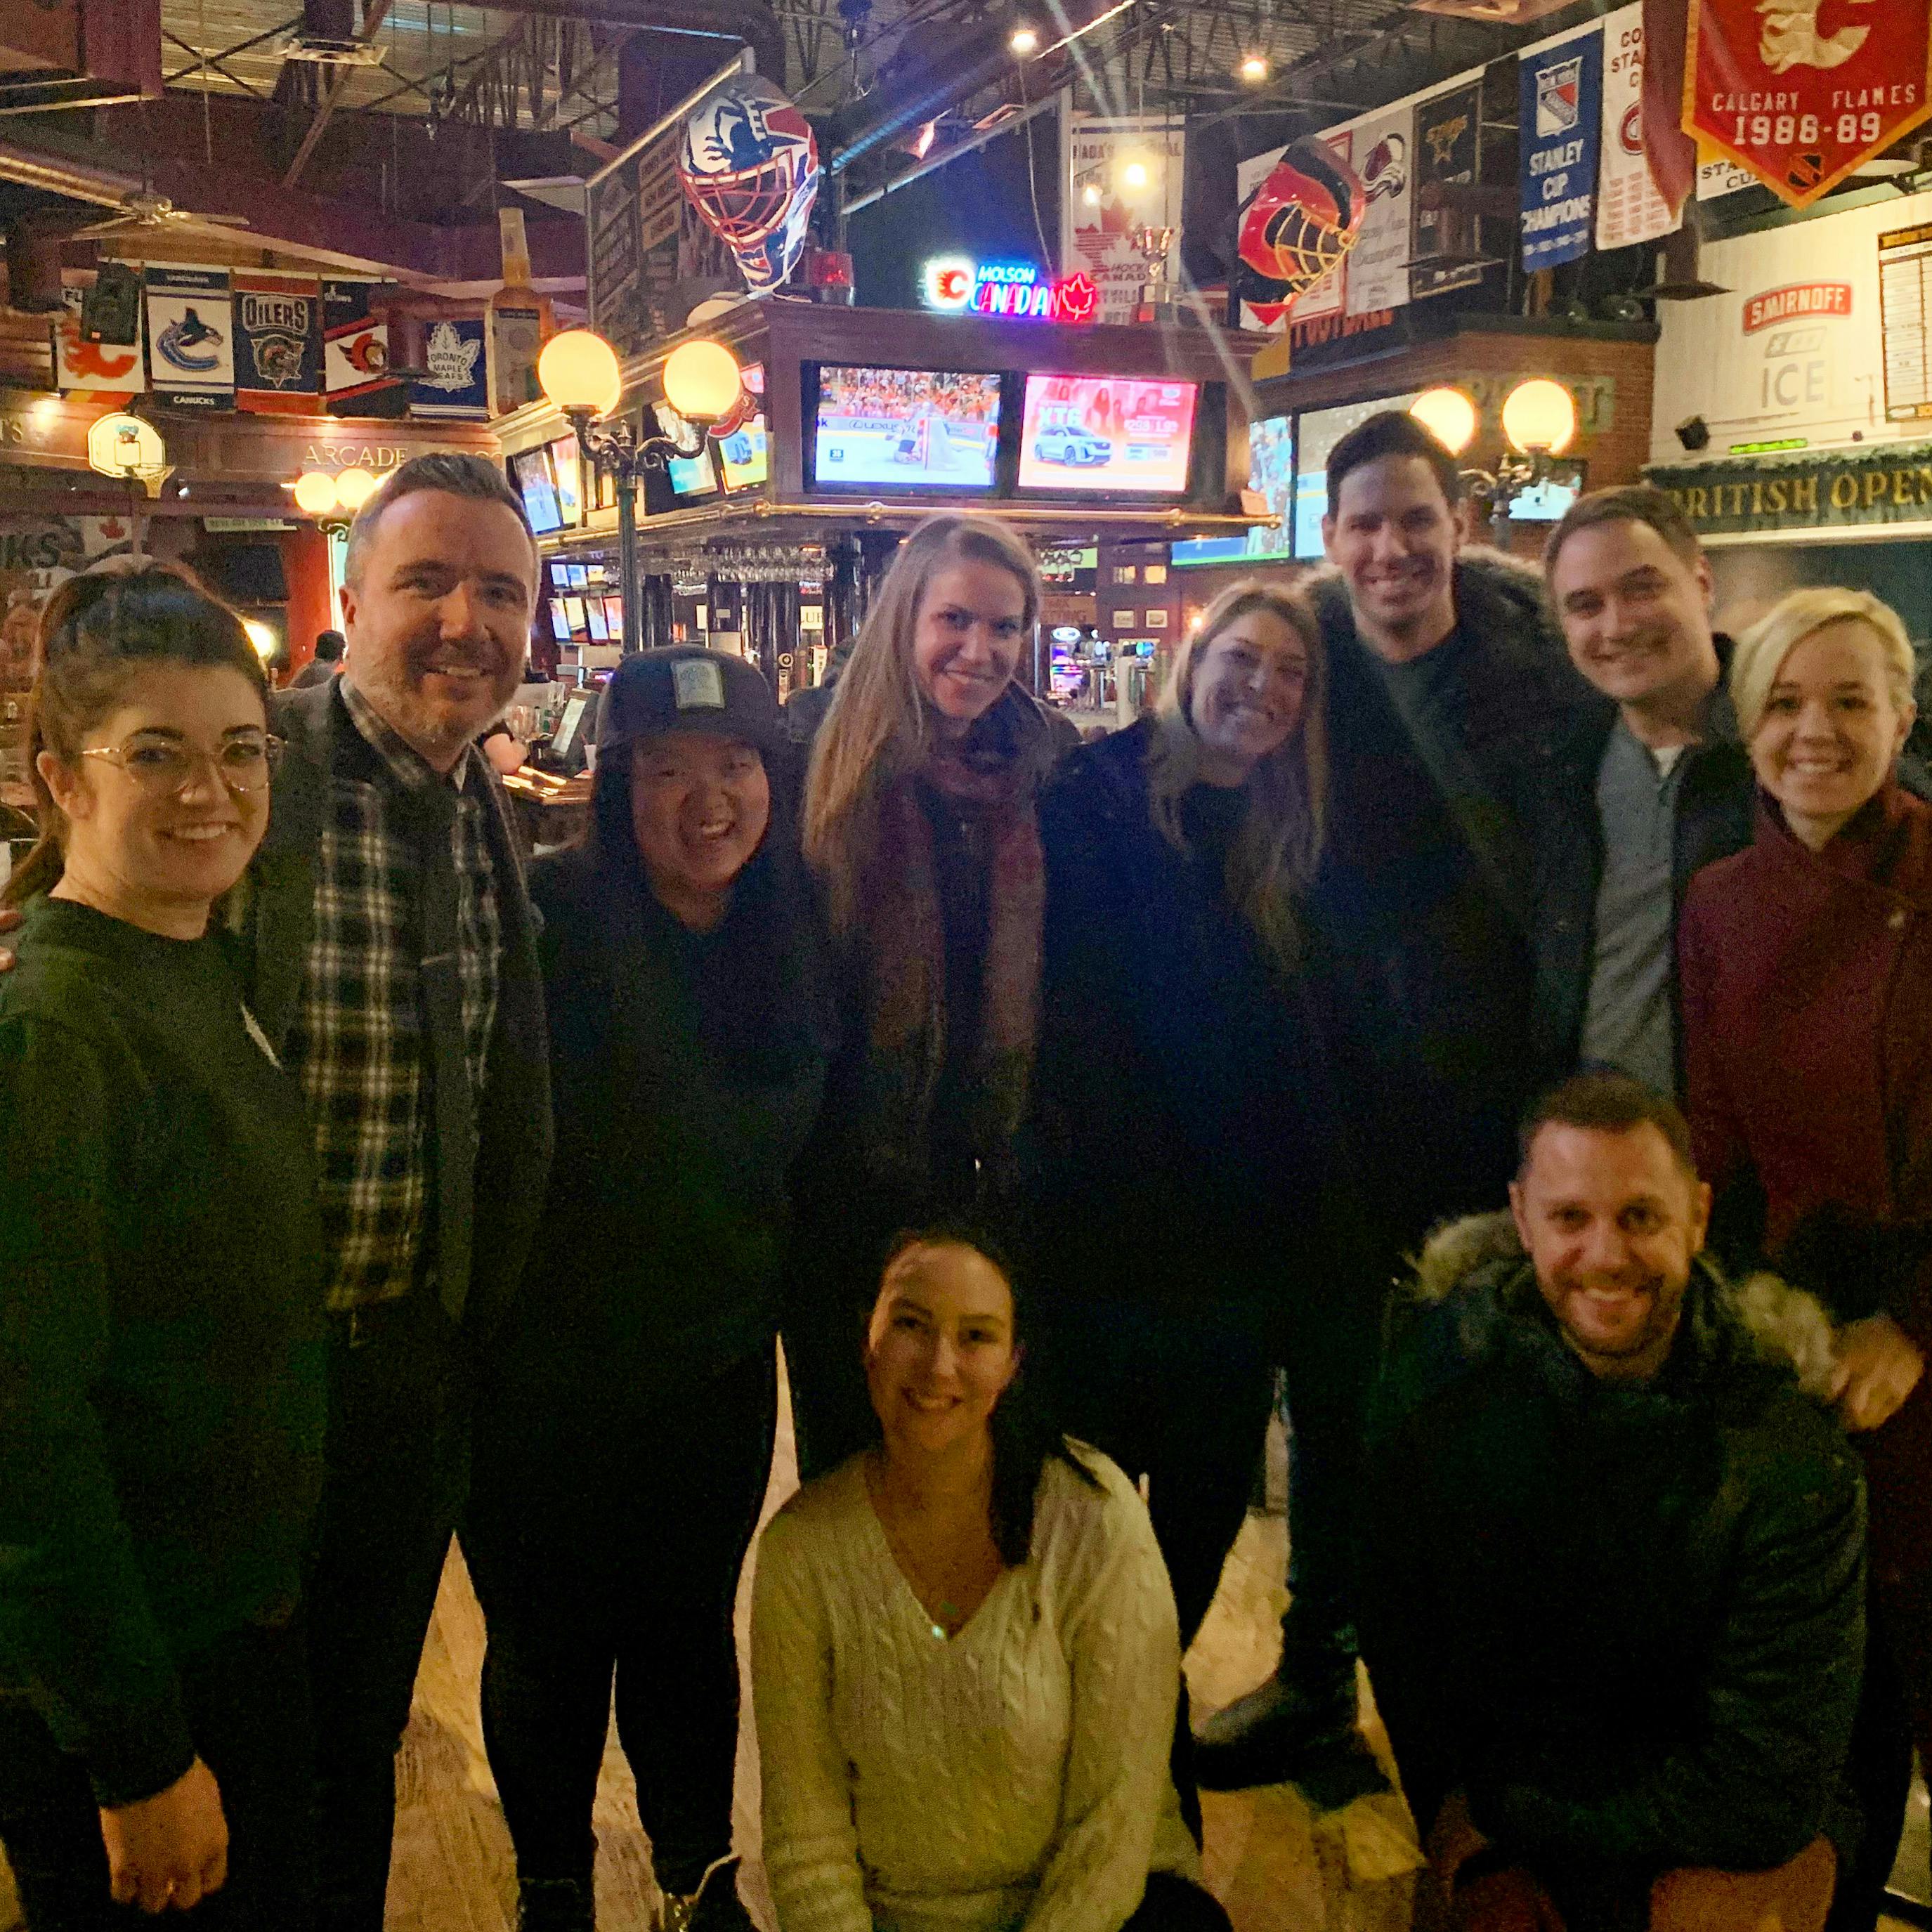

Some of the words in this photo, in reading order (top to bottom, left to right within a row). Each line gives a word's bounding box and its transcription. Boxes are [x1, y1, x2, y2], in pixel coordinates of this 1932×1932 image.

[1620, 27, 1642, 48] CO
[1611, 50, 1643, 73] STA
[1712, 91, 1800, 112] CALGARY
[1832, 83, 1916, 109] FLAMES
[1529, 138, 1584, 176] STANLEY
[1702, 162, 1739, 180] STA
[1542, 172, 1568, 201] CUP
[977, 266, 1036, 284] MOLSON
[970, 282, 1063, 318] CANADIAN
[1750, 287, 1846, 326] SMIRNOFF
[243, 295, 309, 334] OILERS
[433, 364, 462, 372] MAPLE
[438, 372, 464, 381] EAFS
[1761, 360, 1825, 409] ICE
[173, 396, 215, 405] CANUCKS
[863, 422, 899, 433] LEXUS
[303, 445, 408, 467] ARCADE
